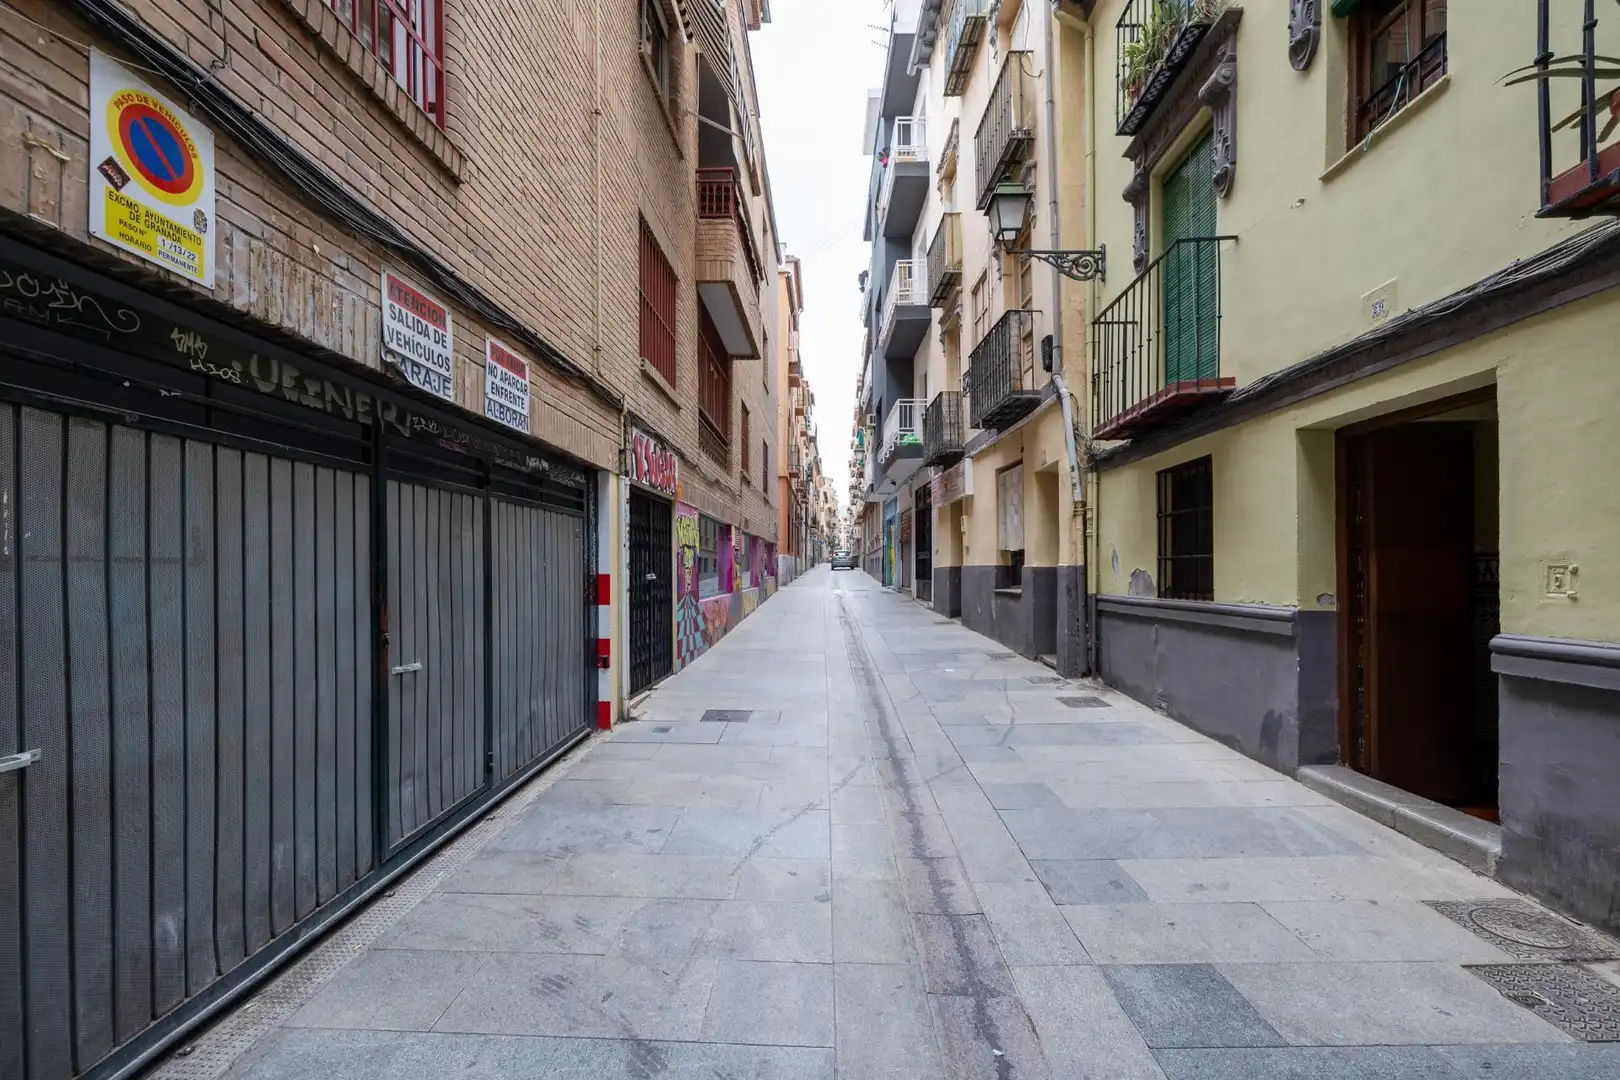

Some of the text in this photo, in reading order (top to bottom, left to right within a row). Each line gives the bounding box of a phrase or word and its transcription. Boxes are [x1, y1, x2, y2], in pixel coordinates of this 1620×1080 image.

[113, 93, 134, 110] PASO
[136, 93, 149, 104] DE
[109, 190, 202, 246] EXCMO. AYUNTAMIENTO
[119, 218, 138, 233] PASO
[129, 211, 182, 244] DE GRANADA
[119, 231, 152, 252] HORARIO
[158, 249, 198, 274] PERMANENTE
[389, 303, 447, 349] SALIDA DE
[387, 324, 451, 373] VEHÍCULOS
[488, 361, 528, 397] NO APARCAR
[491, 382, 525, 410] ENFRENTE
[487, 400, 529, 432] ALBORAN
